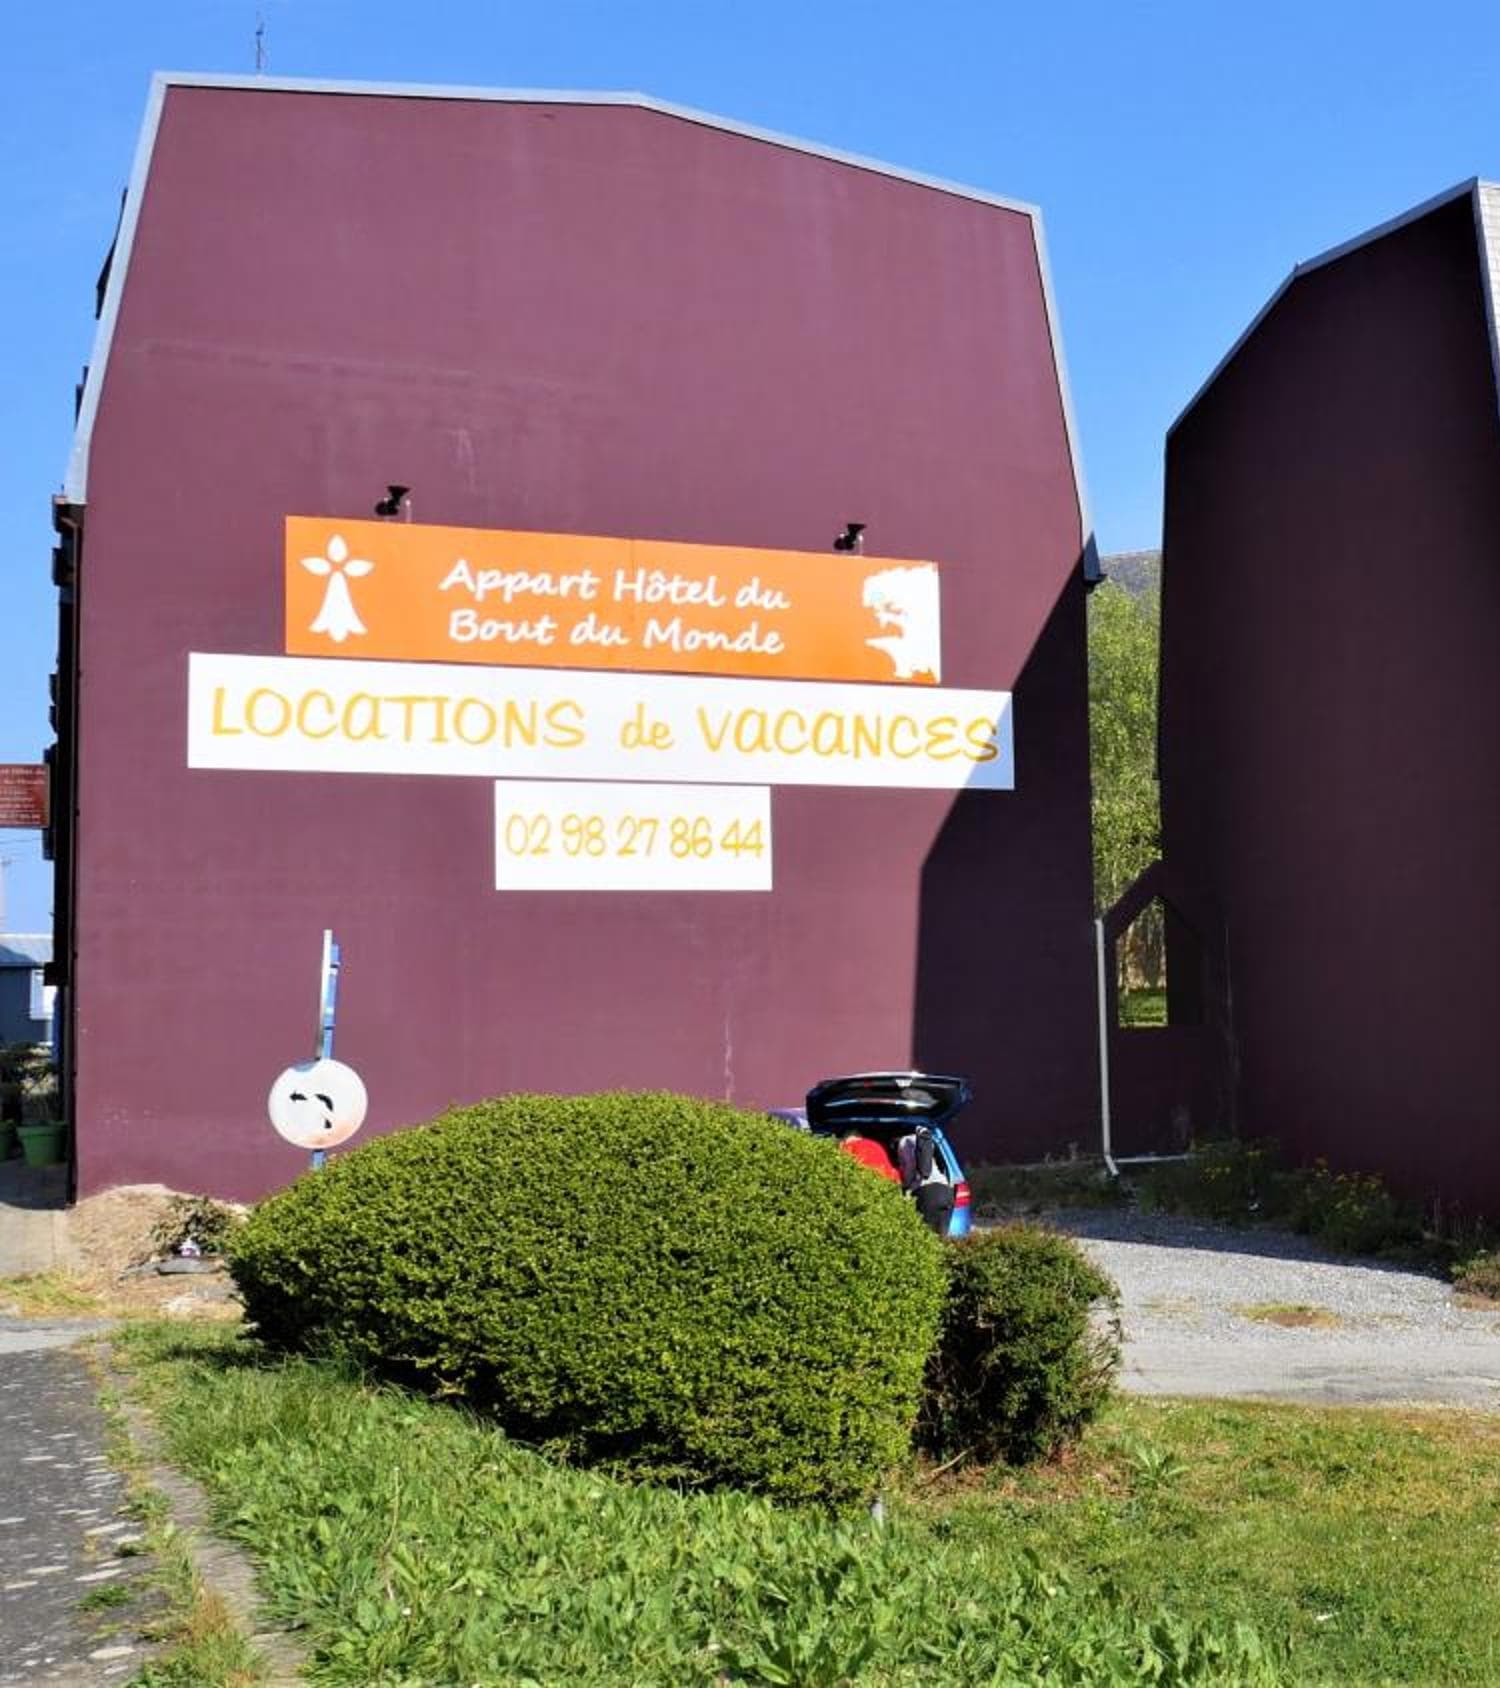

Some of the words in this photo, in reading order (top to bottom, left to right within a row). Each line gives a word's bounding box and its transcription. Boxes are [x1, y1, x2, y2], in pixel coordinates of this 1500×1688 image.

[439, 558, 602, 603] Appart
[613, 567, 728, 608] Hôtel
[734, 575, 791, 611] du
[447, 607, 558, 646] Bout
[569, 612, 629, 647] du
[642, 616, 785, 655] Monde
[211, 687, 586, 749] LOCATIONS
[621, 703, 674, 751] de
[697, 708, 999, 763] VACANCES
[505, 813, 550, 857] 02
[562, 813, 607, 857] 98
[616, 814, 660, 857] 27
[669, 816, 713, 858] 86
[719, 818, 765, 858] 44
